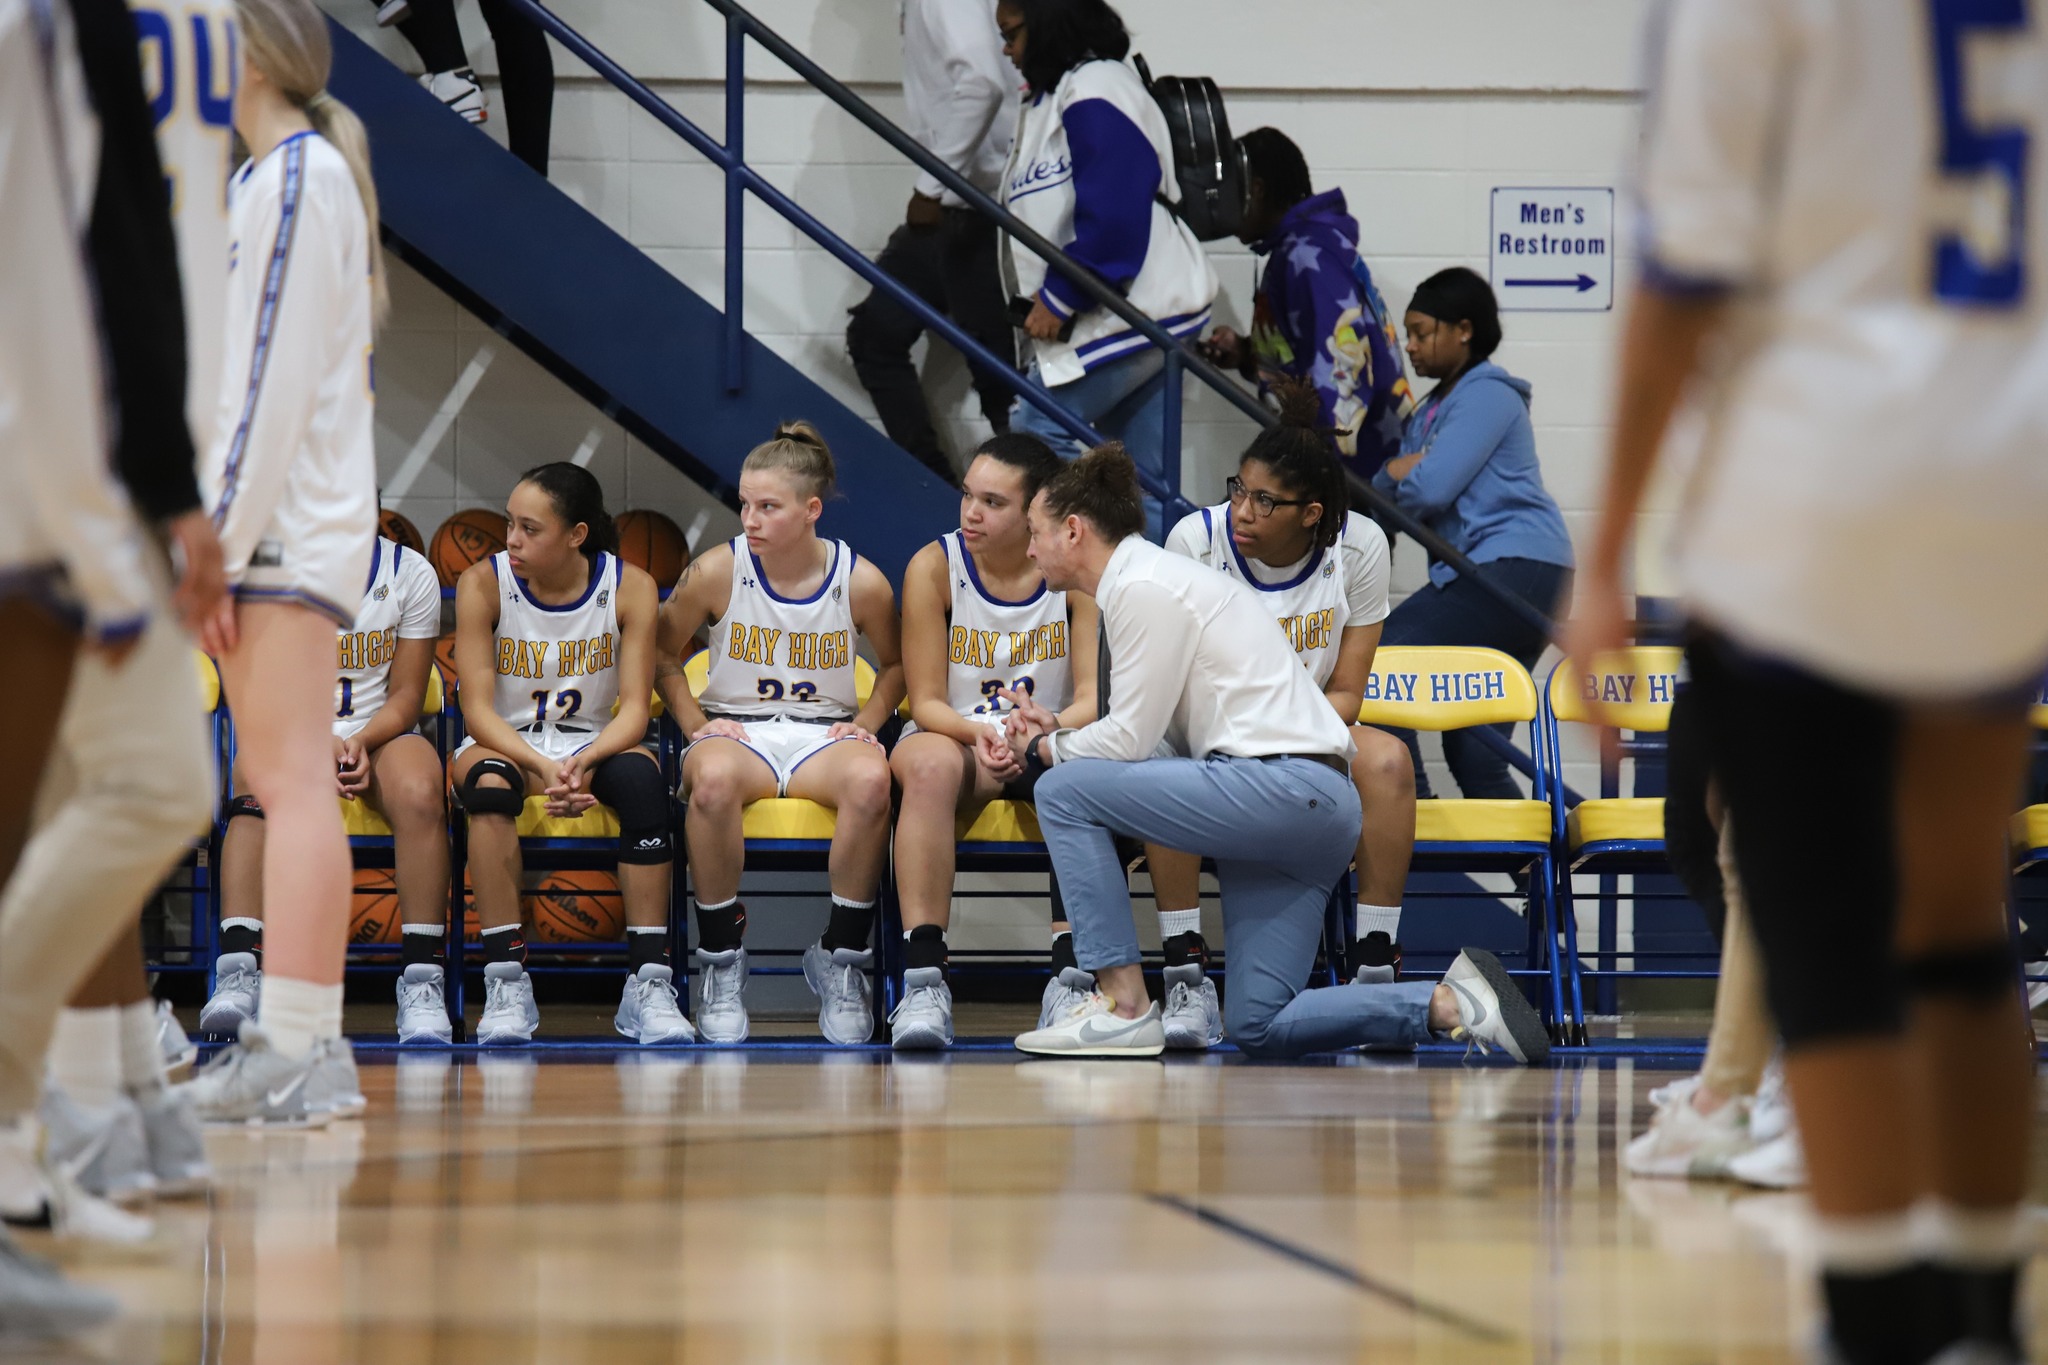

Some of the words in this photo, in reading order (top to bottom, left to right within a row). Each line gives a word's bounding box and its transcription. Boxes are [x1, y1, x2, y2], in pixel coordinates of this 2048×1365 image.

[1928, 0, 2026, 310] 5
[1520, 202, 1585, 225] Men's
[1499, 233, 1605, 255] Restroom
[497, 637, 549, 679] BAY
[557, 632, 614, 677] HIGH
[729, 621, 781, 666] BAY
[787, 629, 849, 670] HIGH
[950, 625, 1001, 669] BAY
[1009, 620, 1066, 668] HIGH
[1364, 672, 1418, 702] BAY
[1429, 670, 1506, 703] HIGH
[1581, 673, 1636, 703] BAY
[531, 688, 582, 721] 12
